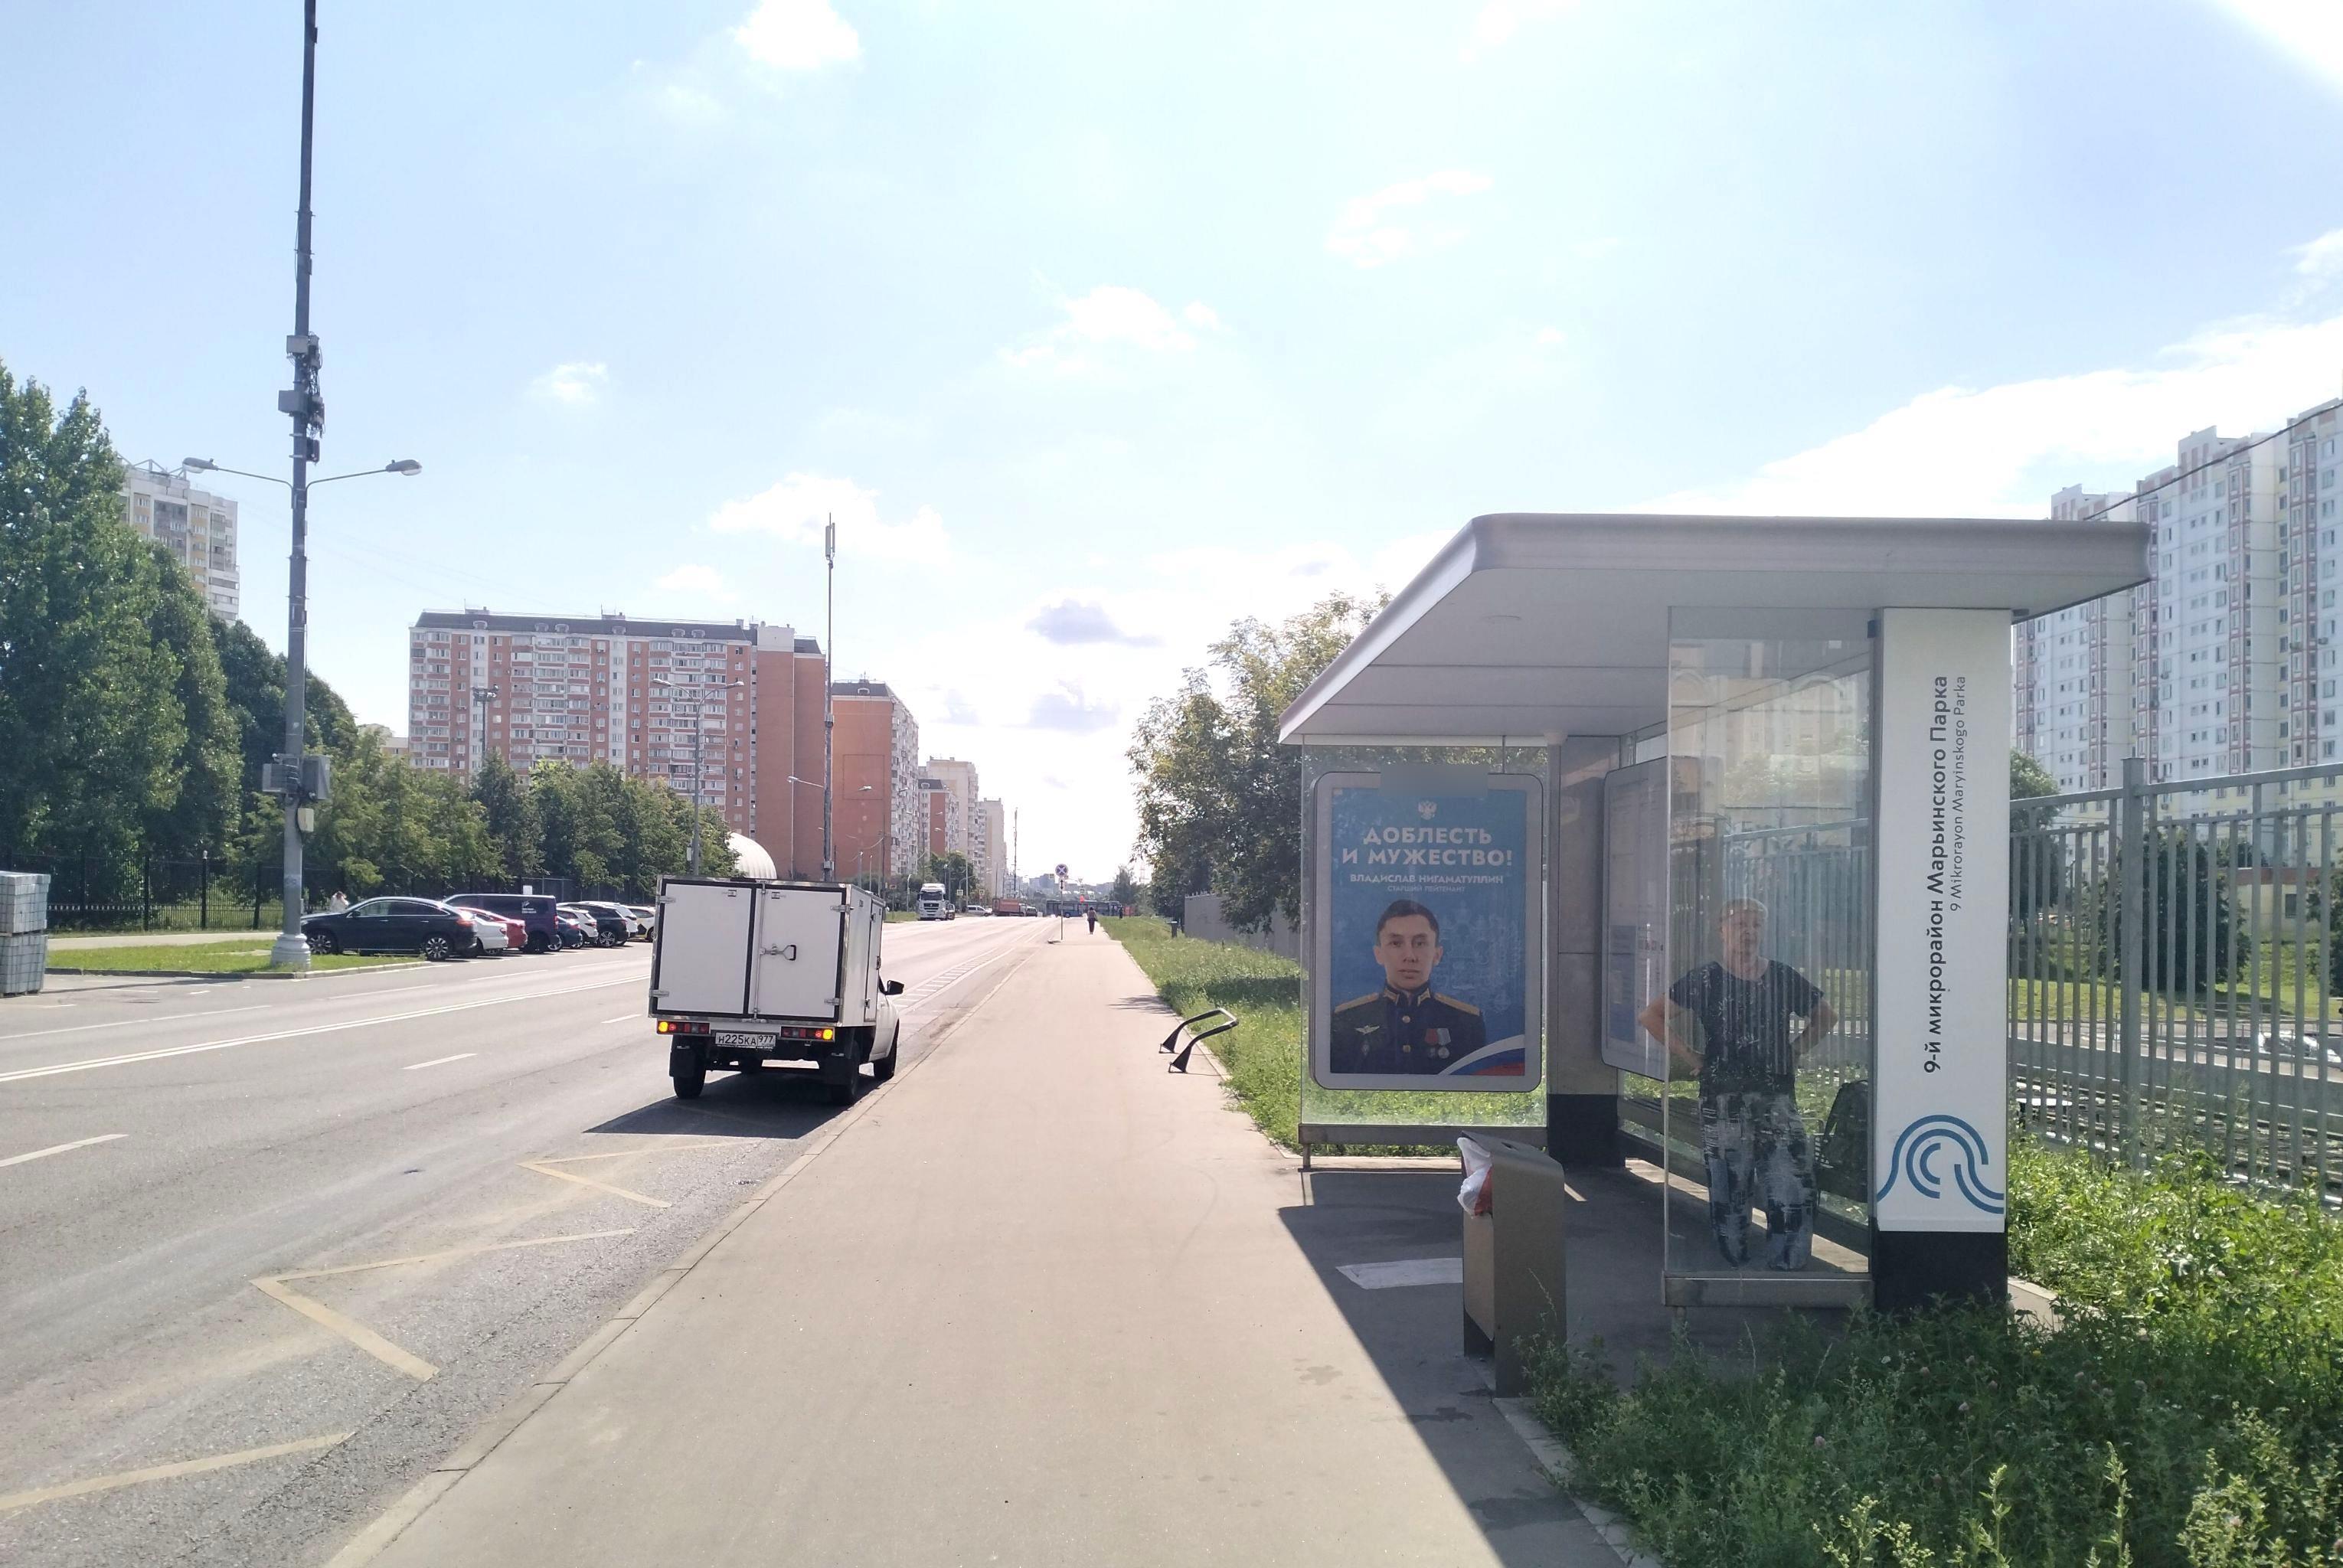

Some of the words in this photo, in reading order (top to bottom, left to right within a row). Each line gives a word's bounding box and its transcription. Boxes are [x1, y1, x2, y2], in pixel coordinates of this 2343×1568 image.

[1930, 676, 1951, 741] Парка
[1953, 676, 1966, 715] Parka
[1952, 720, 1967, 812] Maryinskogo
[1363, 827, 1492, 845] ДОБЛЕСТЬ
[1926, 749, 1949, 894] Марьинского
[1342, 848, 1358, 864] И
[1368, 849, 1512, 866] МУЖЕСТВО!
[1950, 816, 1966, 899] Mikrorayon
[1350, 874, 1416, 884] ВЛАДИСЛАВ
[1949, 903, 1962, 911] 9
[1926, 900, 1946, 1035] микрорайон
[1923, 1041, 1942, 1073] 9-й
